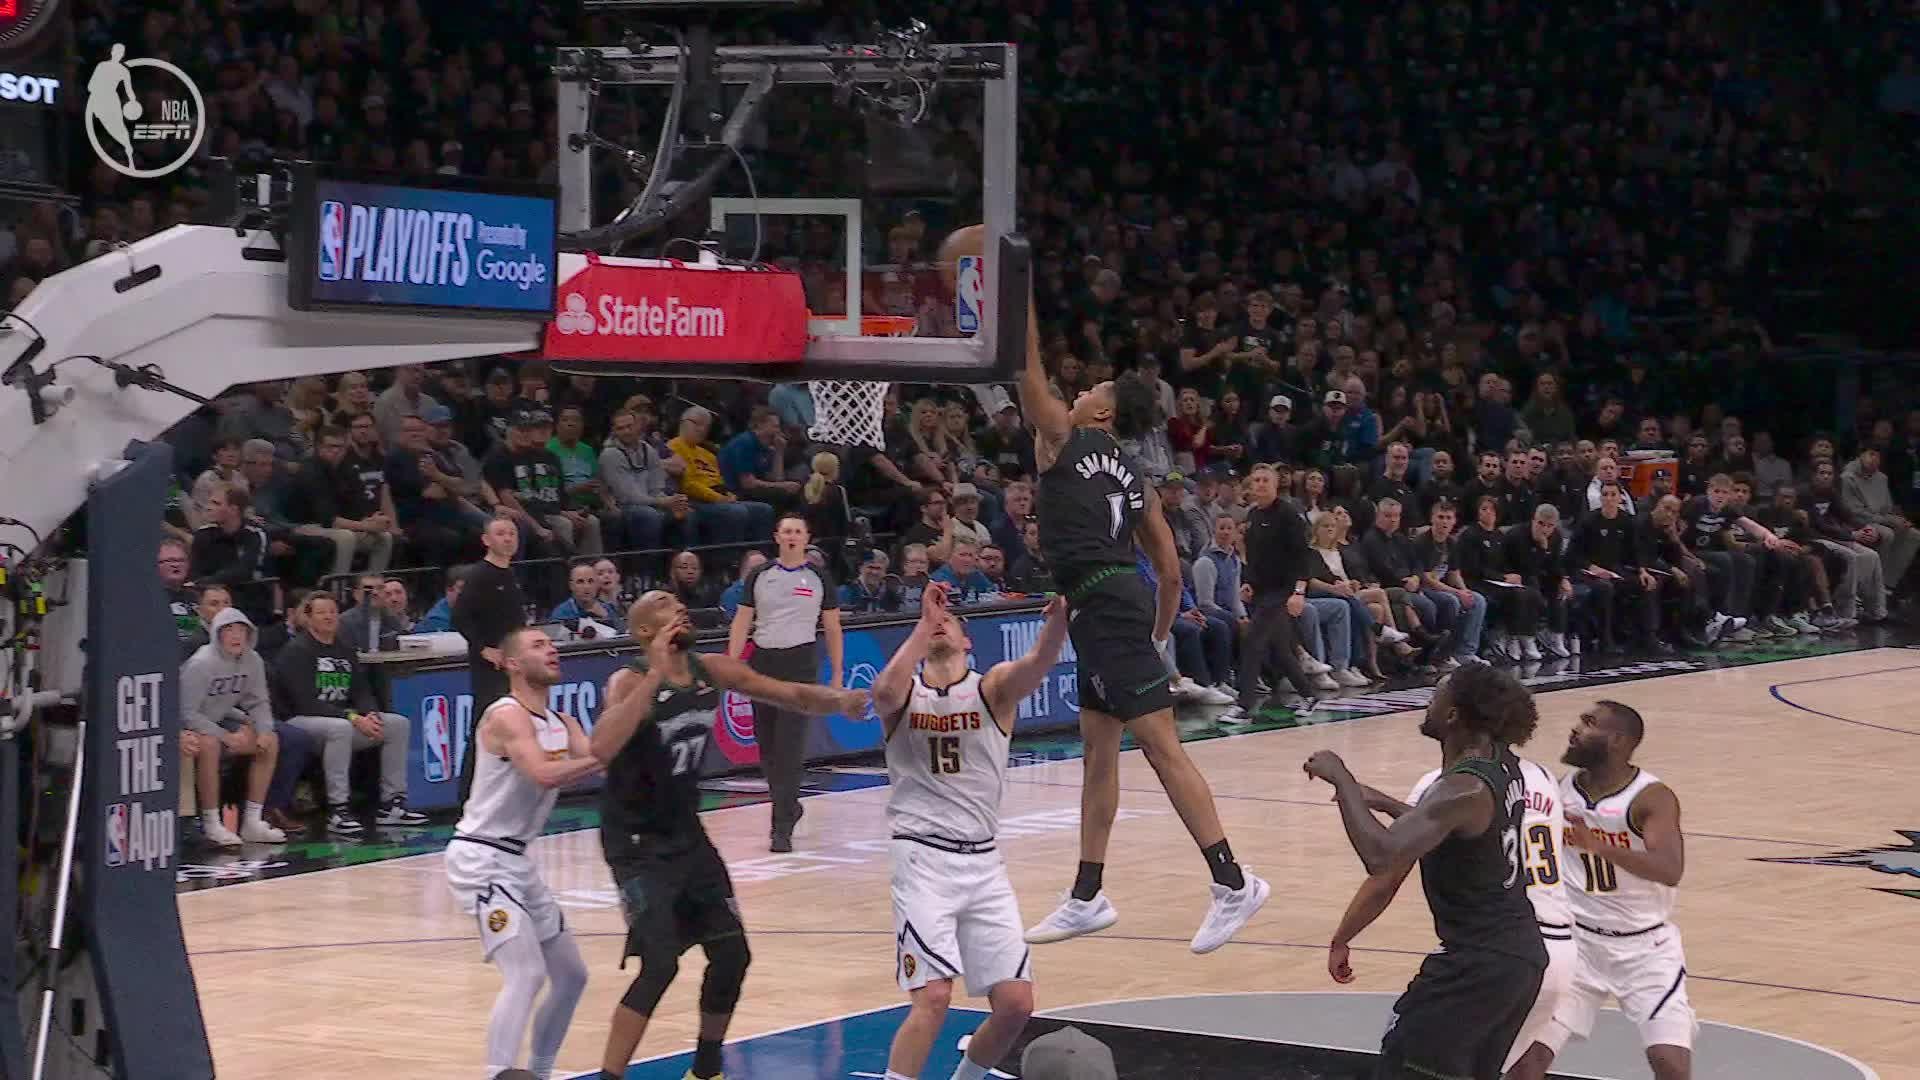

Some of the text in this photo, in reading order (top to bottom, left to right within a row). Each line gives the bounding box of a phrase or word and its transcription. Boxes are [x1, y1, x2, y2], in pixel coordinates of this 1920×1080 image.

[0, 72, 60, 104] SOT
[344, 204, 473, 287] PLAYOFFS
[476, 248, 546, 290] Google
[1075, 452, 1135, 489] SHANNON
[1104, 491, 1126, 541] 1
[117, 673, 164, 733] GET
[909, 711, 981, 732] NUGGETS
[117, 735, 164, 796] THE
[670, 735, 707, 777] 27
[928, 736, 961, 774] 15
[1523, 791, 1553, 816] SON
[128, 802, 175, 871] App
[1580, 852, 1618, 894] 10
